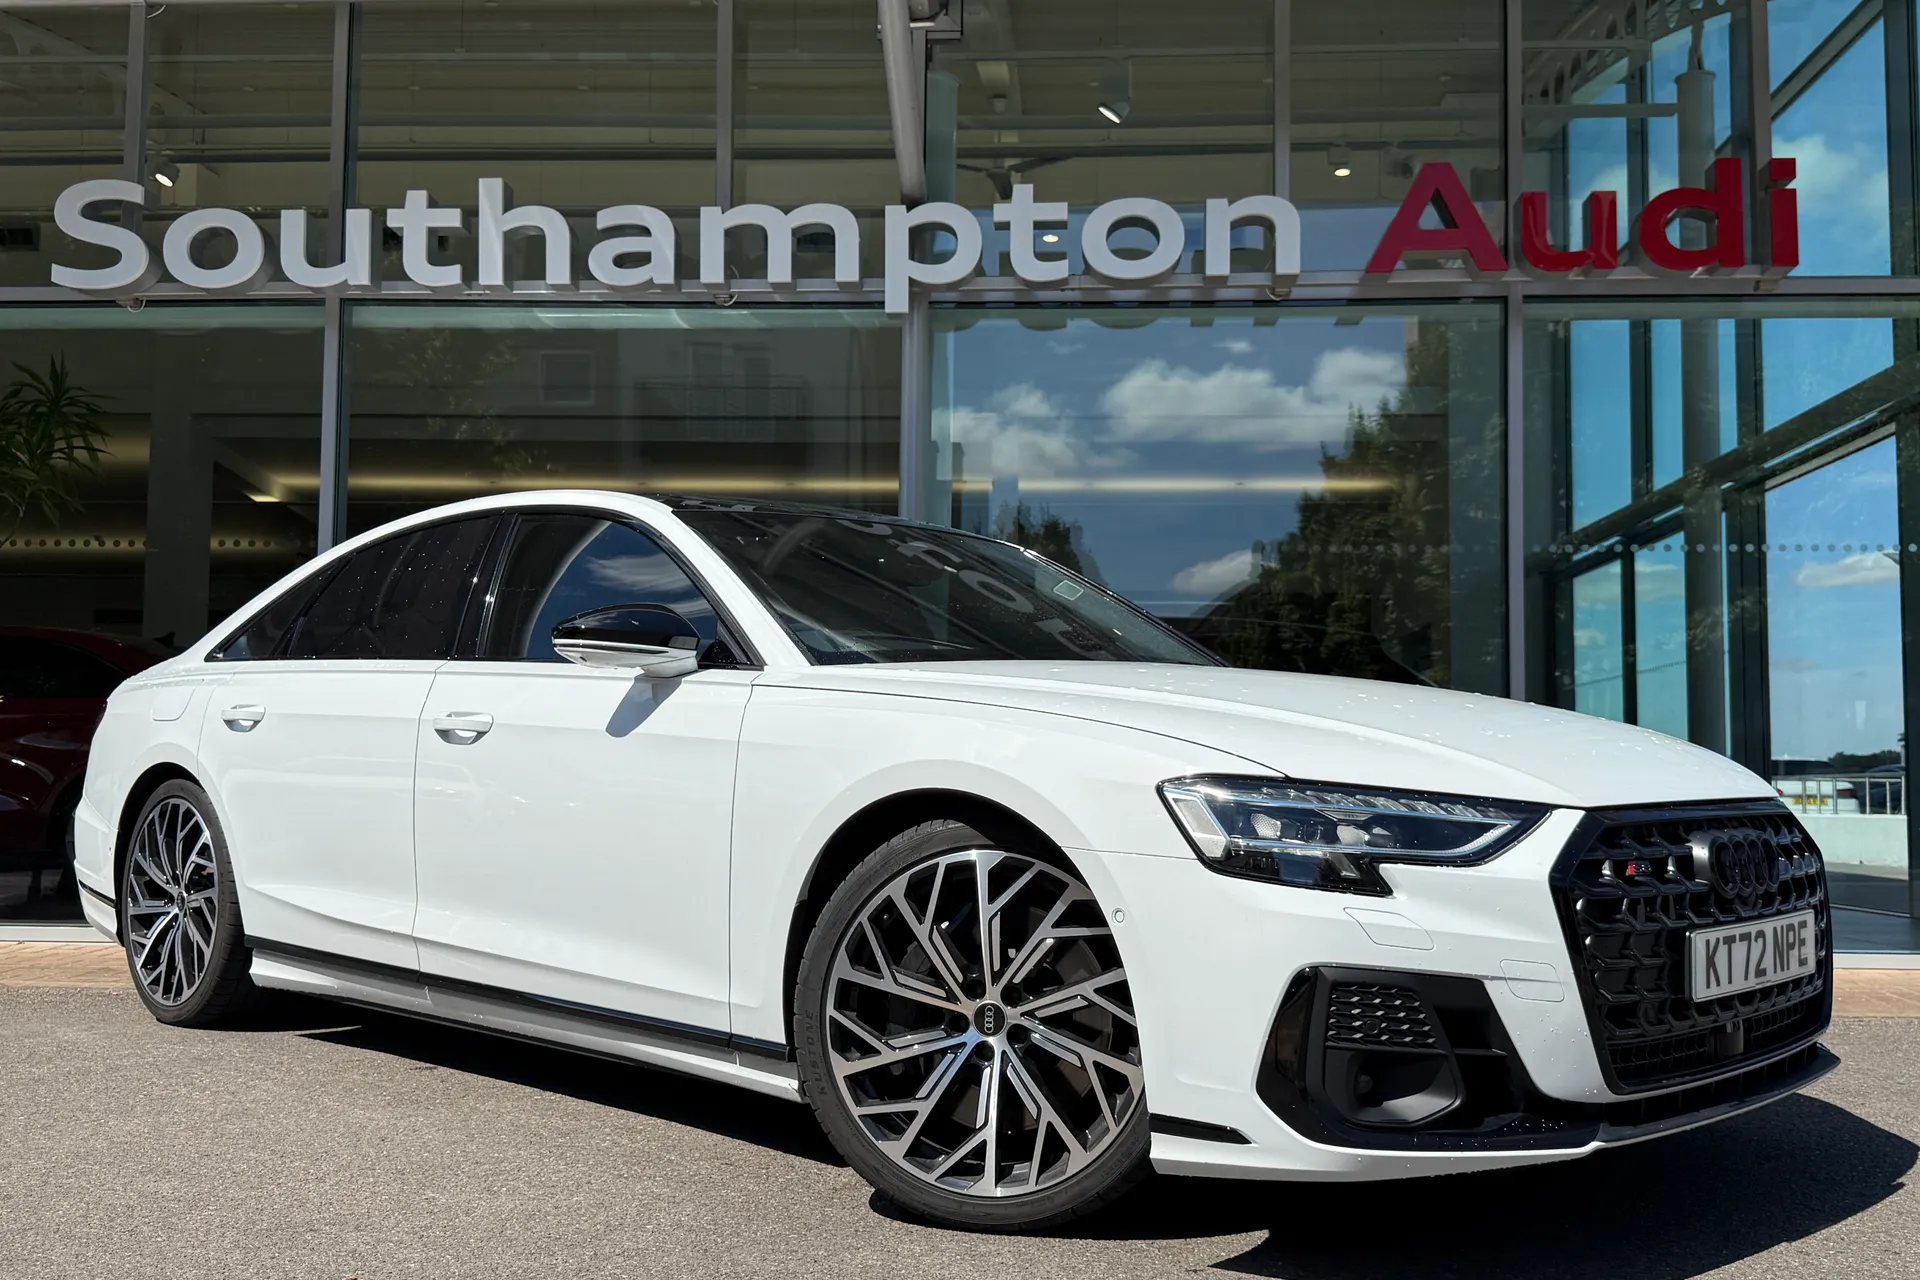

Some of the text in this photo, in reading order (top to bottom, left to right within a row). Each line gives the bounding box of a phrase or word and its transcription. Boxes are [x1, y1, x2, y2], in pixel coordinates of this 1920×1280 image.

[51, 158, 1799, 313] Southampton Audi
[1705, 920, 1808, 989] KT72 NPE
